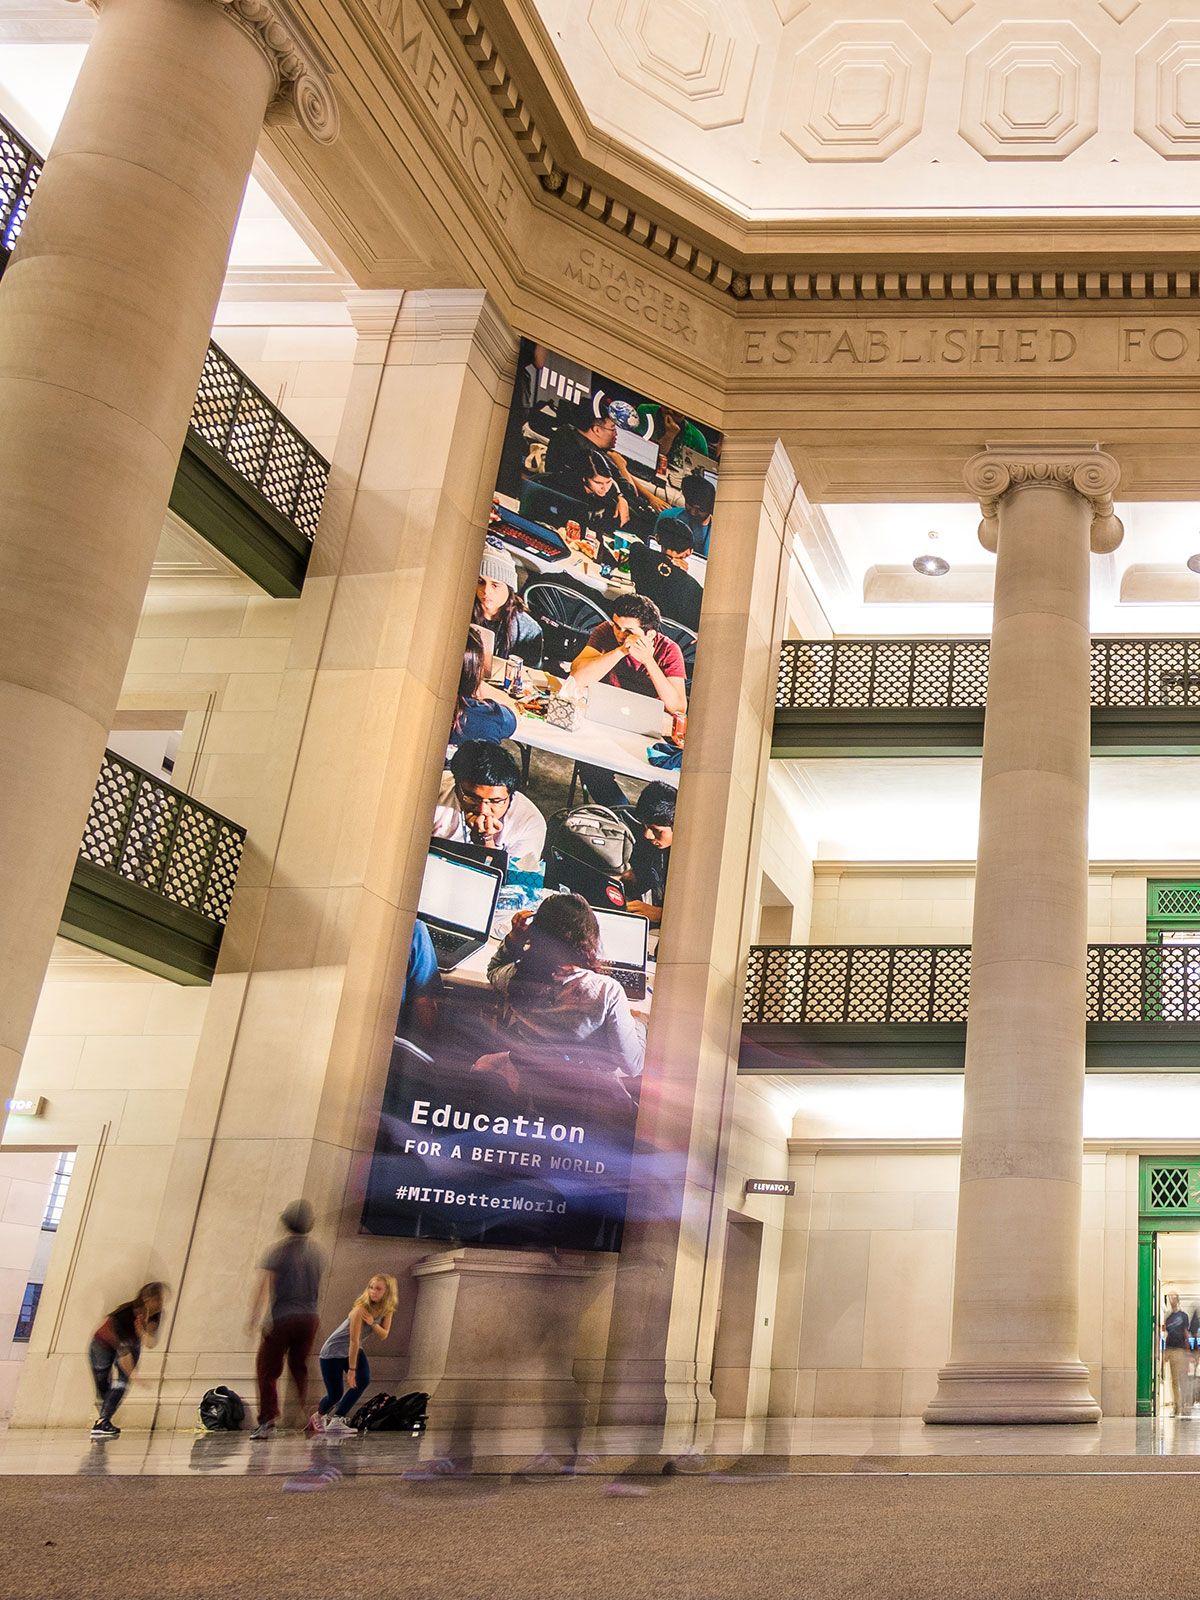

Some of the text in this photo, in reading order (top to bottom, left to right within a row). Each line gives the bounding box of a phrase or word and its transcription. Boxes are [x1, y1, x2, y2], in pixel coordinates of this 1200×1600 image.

[375, 0, 514, 226] MERCE
[563, 262, 698, 345] MDCCCLXI
[580, 248, 691, 321] CHARTER
[740, 329, 1078, 364] ESTABLISHED
[410, 1100, 585, 1144] Education
[404, 1139, 605, 1174] FOR A BETTER WORLD
[395, 1185, 567, 1214] #MITBetterWorld
[753, 1183, 790, 1192] ELEVATOR
